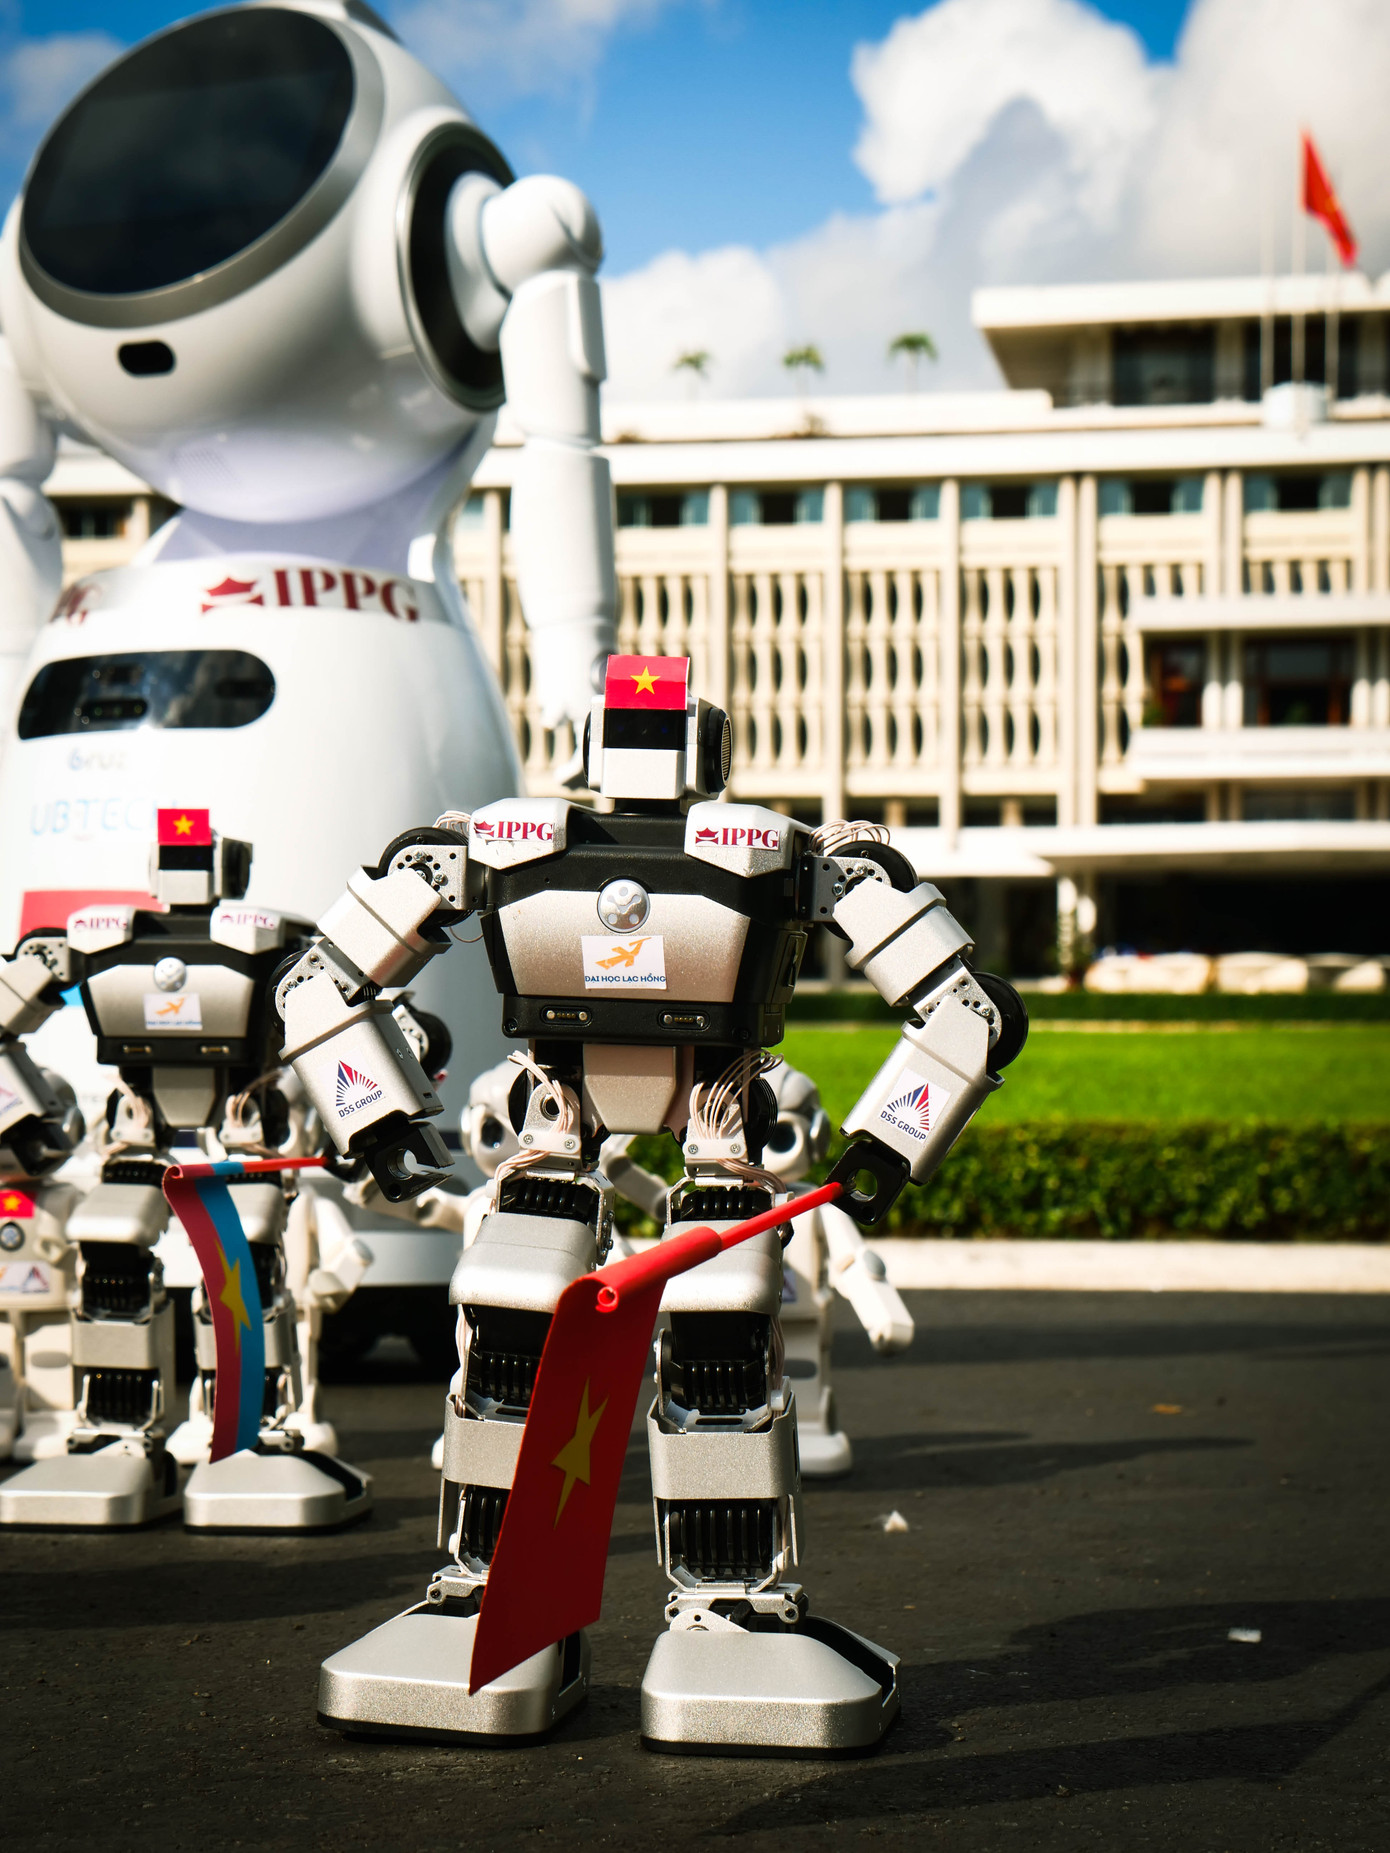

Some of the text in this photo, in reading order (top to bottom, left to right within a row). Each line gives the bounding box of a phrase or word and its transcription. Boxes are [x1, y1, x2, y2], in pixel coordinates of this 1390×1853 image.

[272, 568, 419, 622] IPPG
[497, 821, 554, 841] IPPG
[721, 827, 779, 849] IPPG
[90, 916, 128, 930] IPPG
[338, 1090, 382, 1118] DSS GROUP
[880, 1110, 927, 1140] DSS GROUP
